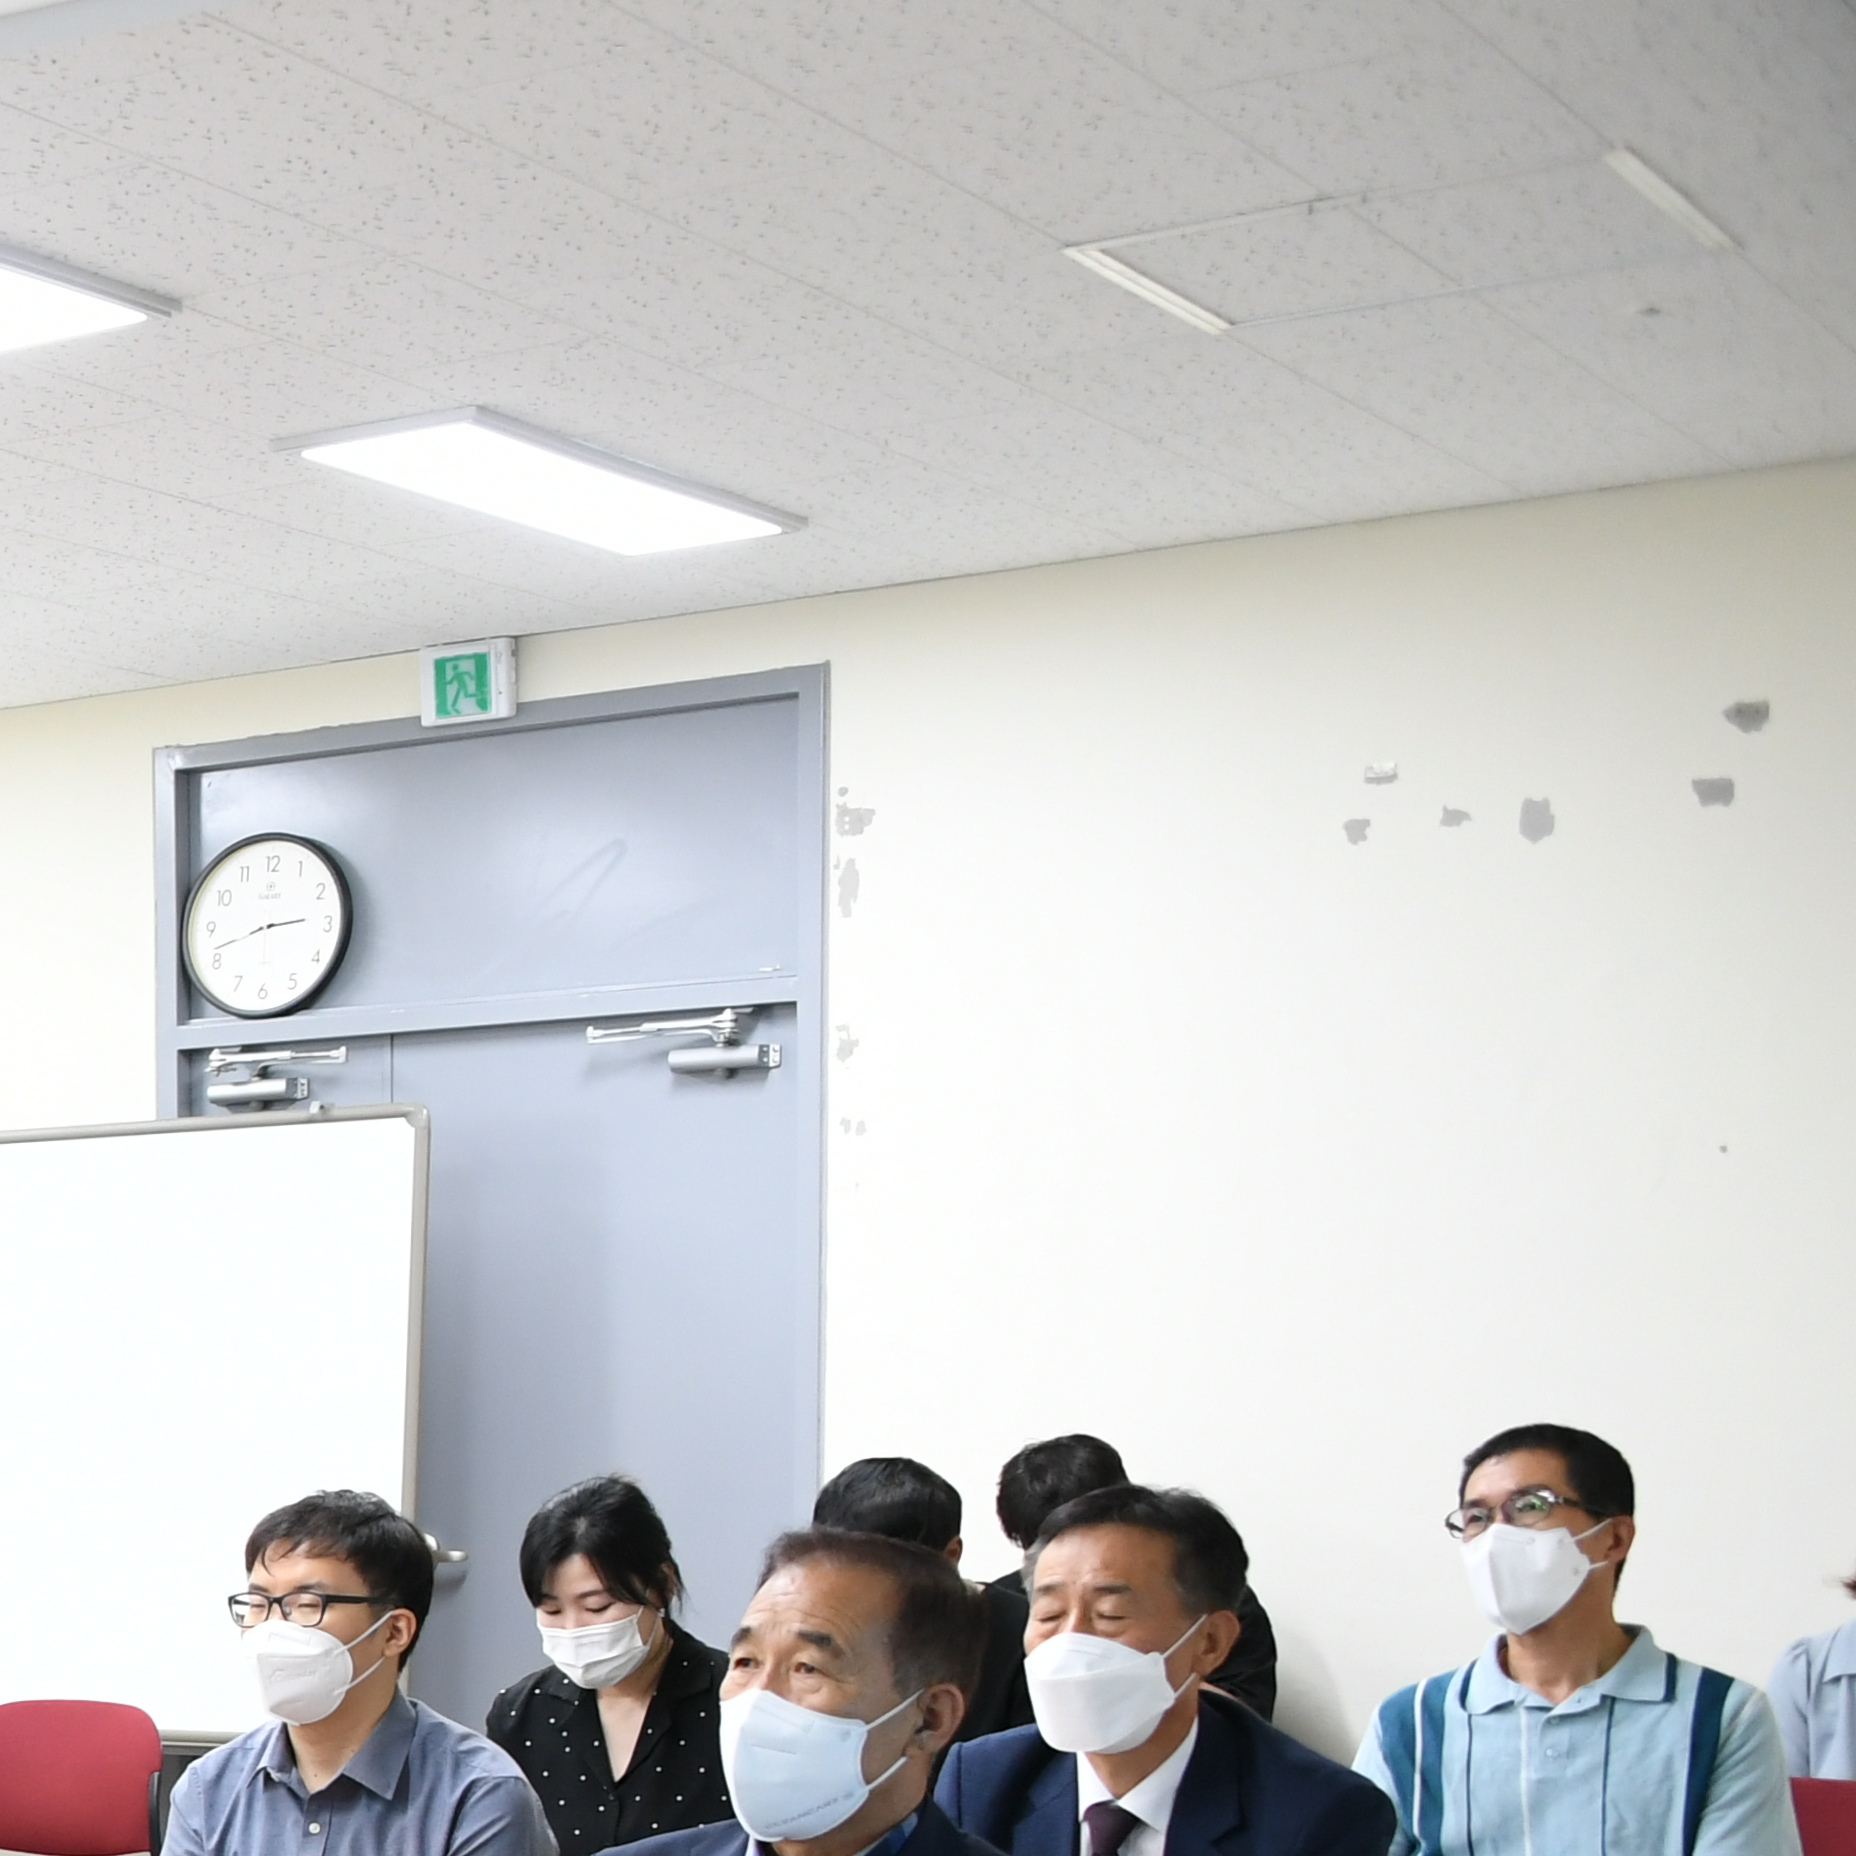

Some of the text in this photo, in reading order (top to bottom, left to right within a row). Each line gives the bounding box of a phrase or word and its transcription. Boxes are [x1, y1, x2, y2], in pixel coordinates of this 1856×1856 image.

[265, 855, 281, 873] 12
[298, 860, 303, 877] 1
[240, 865, 250, 882] 11
[217, 889, 232, 907] 10
[316, 882, 326, 900] 2
[206, 921, 216, 938] 9
[322, 915, 333, 933] 3
[212, 953, 222, 970] 8
[311, 949, 320, 964] 4
[234, 975, 243, 992] 7
[287, 973, 298, 990] 5
[257, 982, 268, 1000] 6
